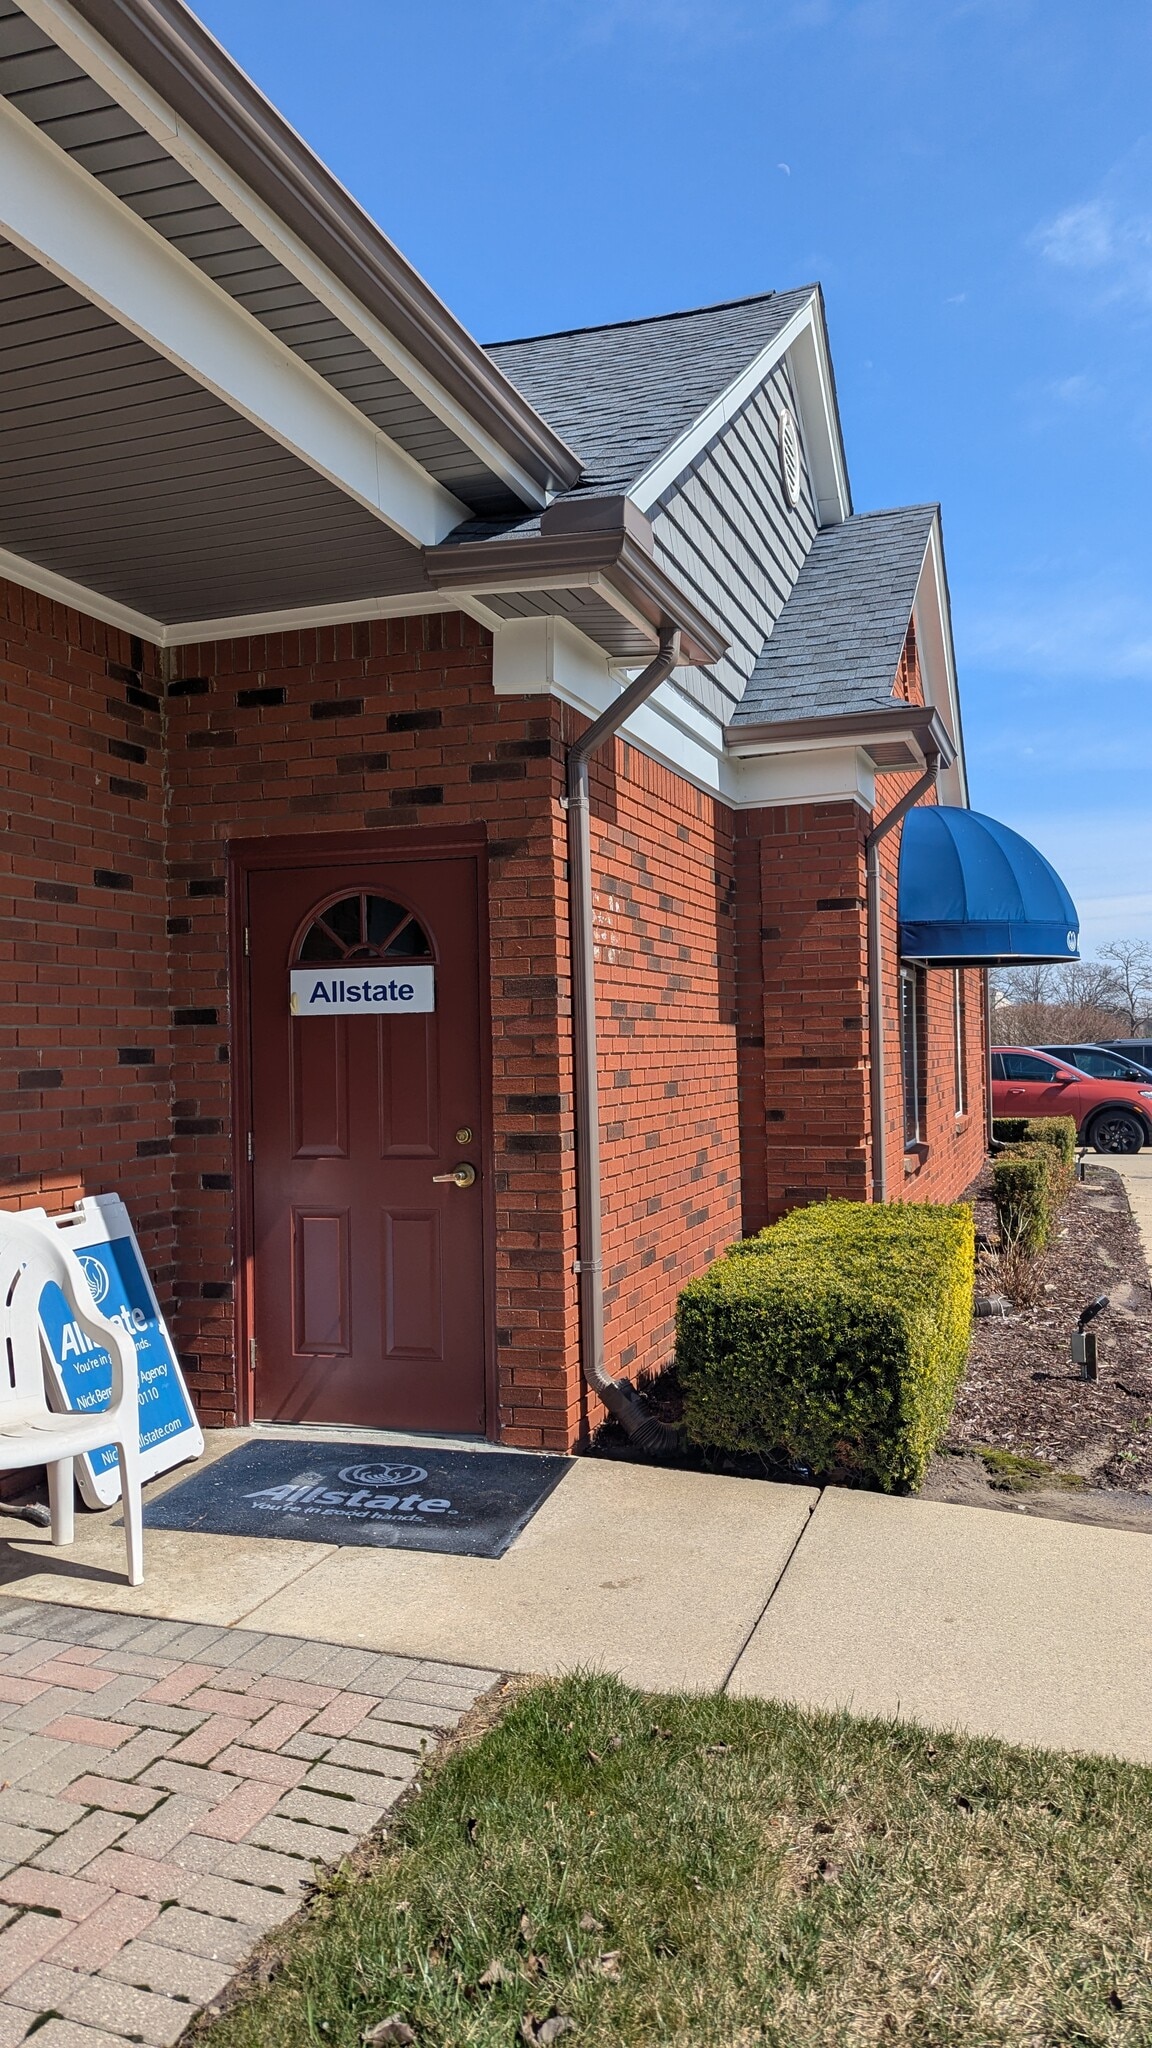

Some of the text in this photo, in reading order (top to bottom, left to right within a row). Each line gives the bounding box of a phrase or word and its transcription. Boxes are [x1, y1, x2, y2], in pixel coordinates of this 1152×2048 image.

[309, 979, 414, 1003] Allstate
[73, 1358, 100, 1374] You're
[99, 1354, 108, 1365] in
[76, 1391, 98, 1410] Nick
[140, 1363, 168, 1384] Agency
[251, 1501, 301, 1512] You're
[303, 1506, 322, 1514] in
[320, 1508, 370, 1518] good
